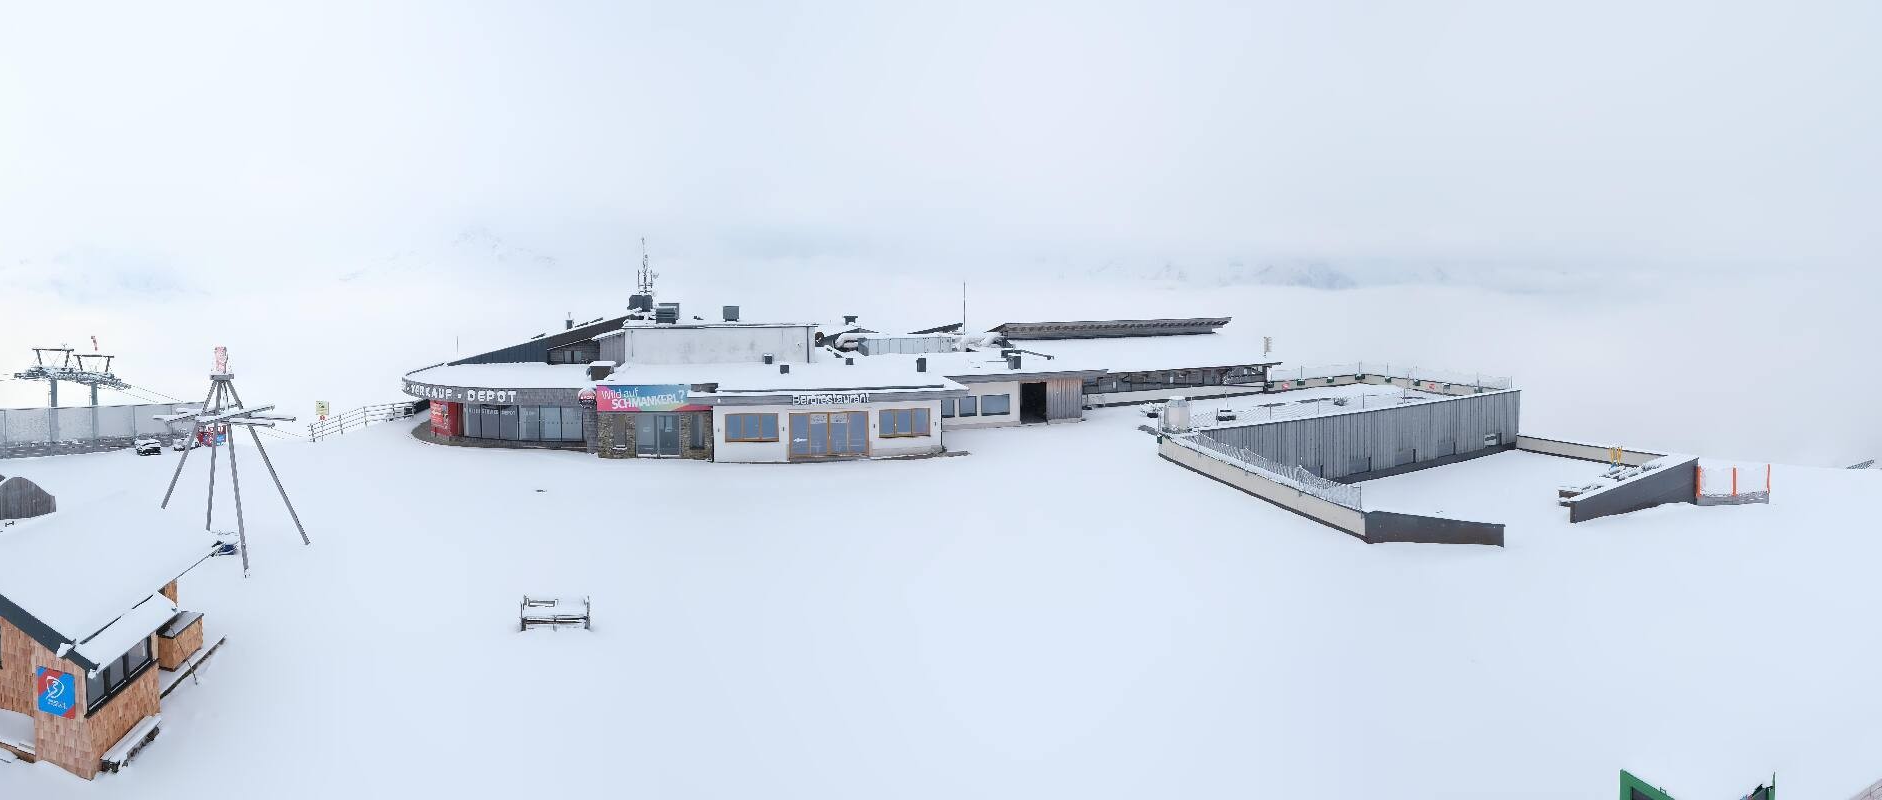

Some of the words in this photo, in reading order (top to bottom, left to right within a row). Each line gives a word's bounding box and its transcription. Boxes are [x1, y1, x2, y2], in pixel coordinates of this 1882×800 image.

[467, 389, 517, 402] DEPOT
[601, 389, 622, 400] Wild
[623, 387, 639, 399] auf
[611, 390, 685, 409] SCHMANKERL?
[792, 393, 870, 405] Bergrestaurant
